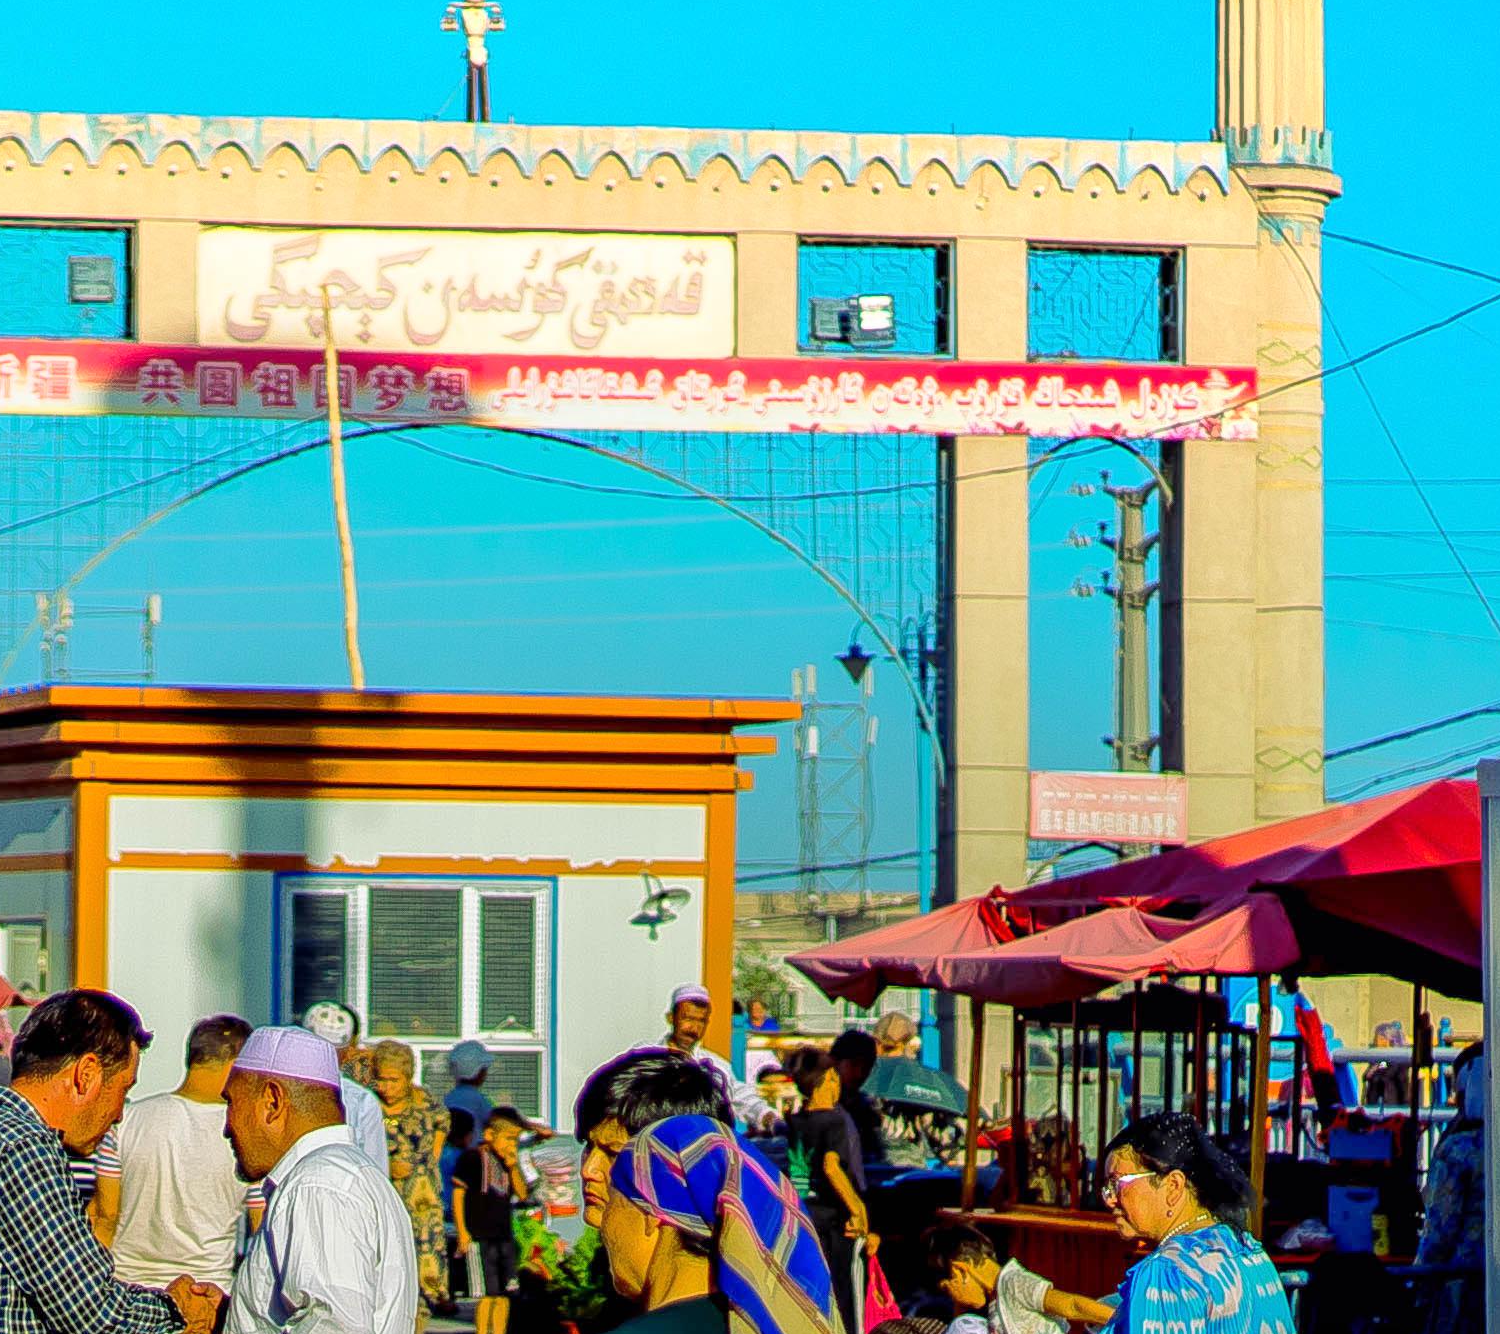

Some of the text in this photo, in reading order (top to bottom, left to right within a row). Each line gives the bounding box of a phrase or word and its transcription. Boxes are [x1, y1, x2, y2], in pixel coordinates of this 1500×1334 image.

[135, 357, 471, 413] 共圆祖国梦想
